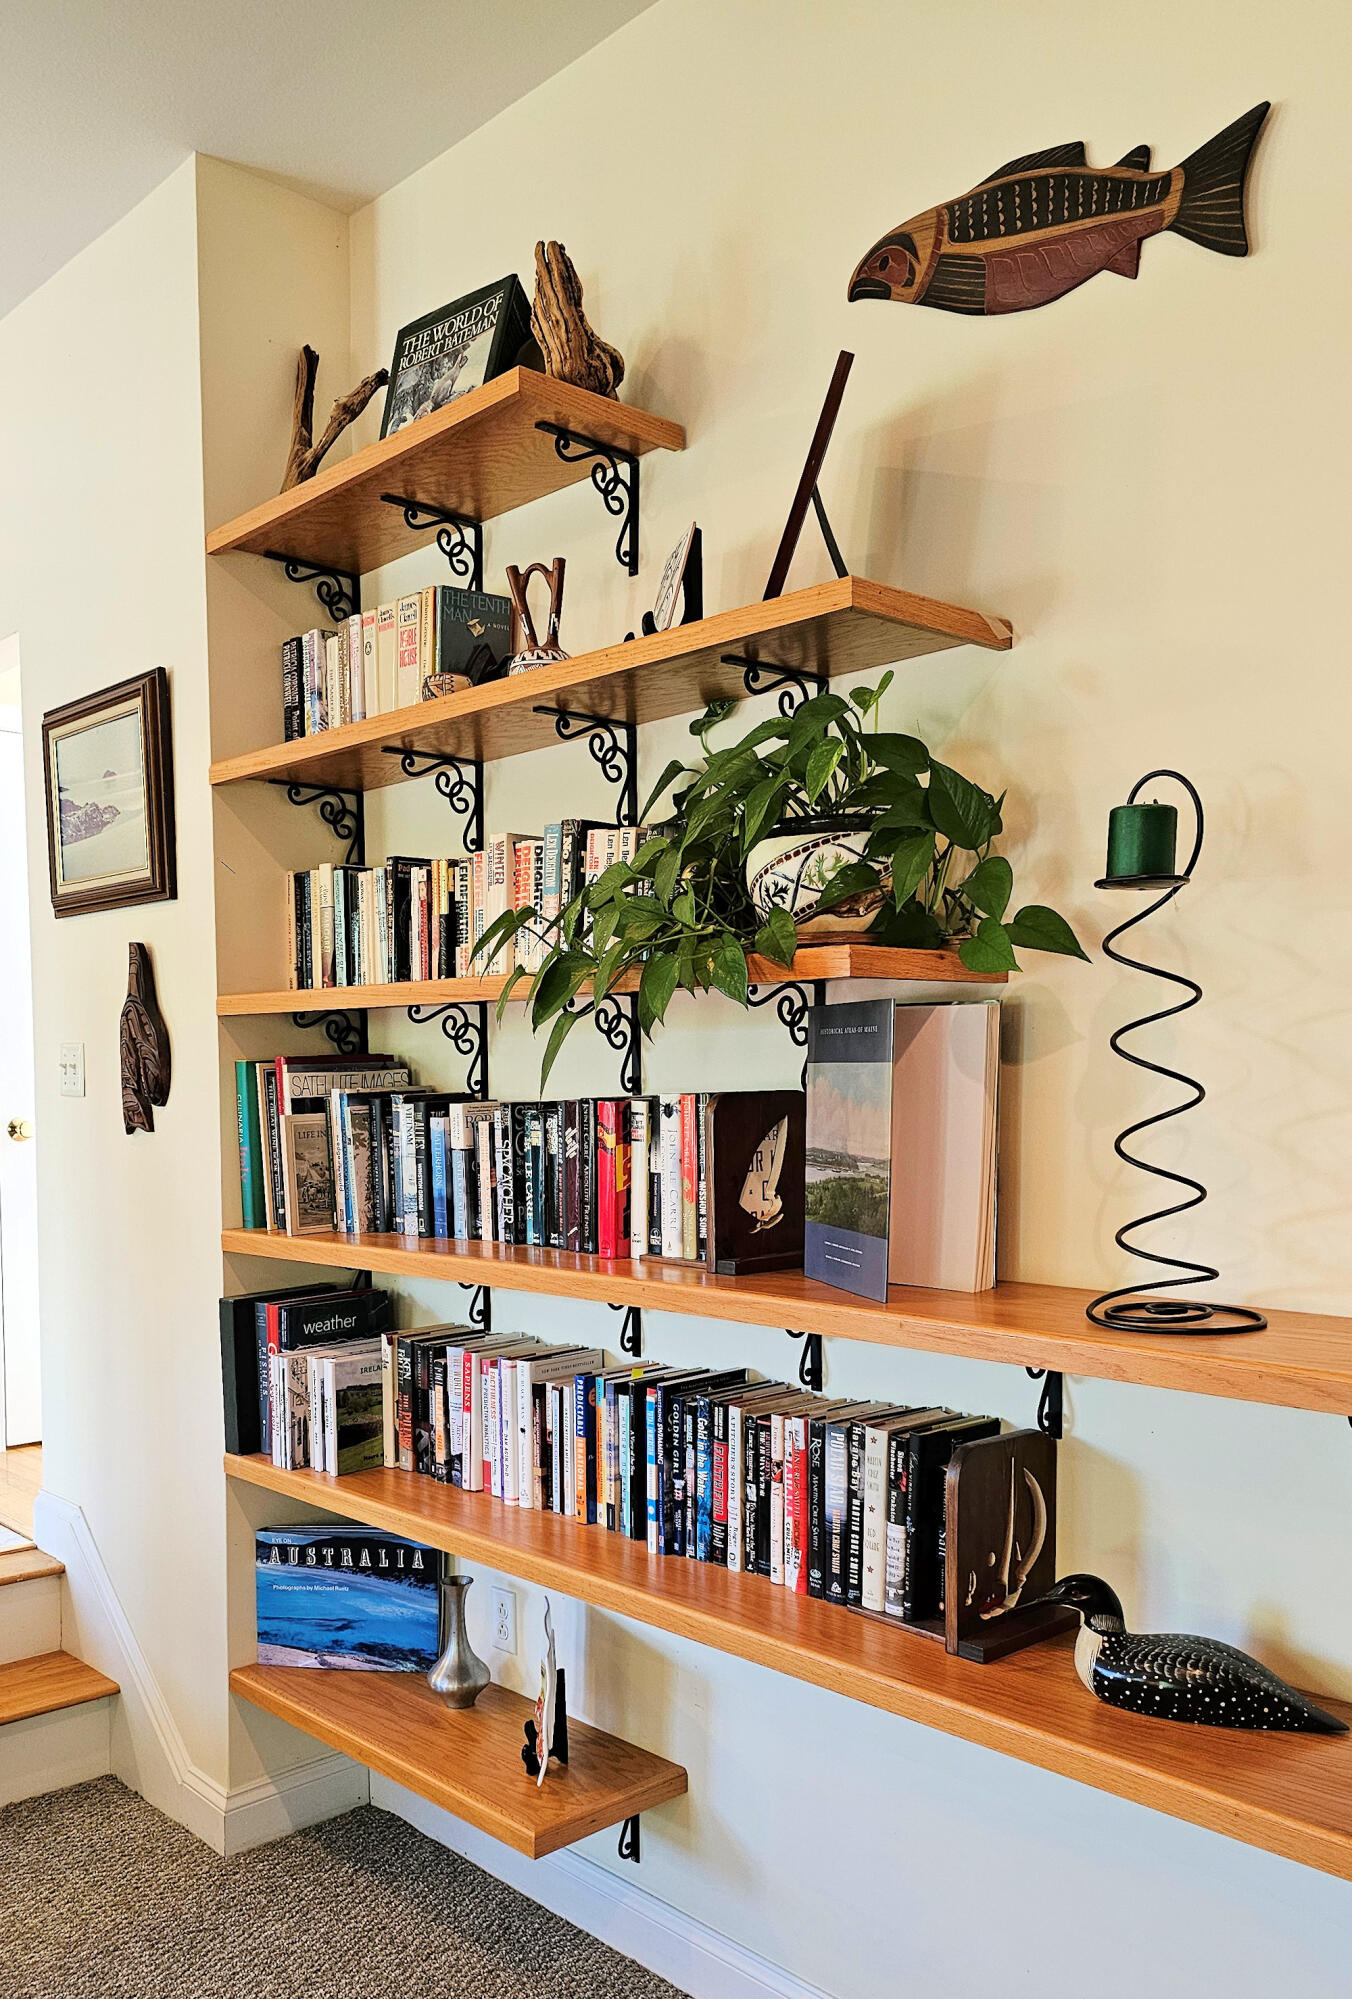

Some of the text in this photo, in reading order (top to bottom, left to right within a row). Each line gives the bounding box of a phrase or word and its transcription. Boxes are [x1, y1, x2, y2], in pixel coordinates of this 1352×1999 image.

[402, 292, 504, 356] THE WORLD OF
[398, 311, 499, 371] ROBERT BATEMAN
[443, 590, 510, 615] THE TENTH
[443, 606, 472, 623] MAN
[493, 624, 510, 632] NOVEL
[399, 647, 417, 668] HOUSE
[283, 644, 292, 707] PATRICIA CORNWELL
[291, 673, 299, 706] CORNWELL
[292, 709, 300, 730] Point
[563, 835, 572, 860] No
[607, 834, 615, 849] Len
[459, 858, 468, 882] LEN
[495, 840, 505, 885] WINTER
[546, 833, 558, 888] LEN DEIGHTON
[475, 853, 483, 909] FIGHTER
[387, 906, 393, 914] to
[459, 884, 468, 944] DEIGHTON
[819, 1025, 878, 1035] HISTORICAL ATLAS OF MAINE
[291, 1071, 409, 1097] SATELLITE IMAGES
[405, 1107, 414, 1145] VIETNAM
[682, 1101, 691, 1121] JOHN
[297, 1131, 315, 1140] LIFE
[415, 1122, 425, 1150] ALLIES
[667, 1129, 679, 1161] JOHN
[240, 1146, 250, 1184] Italy
[433, 1131, 443, 1186] MATTERHORN
[525, 1162, 532, 1179] LE
[502, 1140, 514, 1224] SPYCATCHER
[667, 1170, 679, 1184] LE
[698, 1181, 707, 1239] MISSION SONG
[303, 1314, 357, 1335] weather
[402, 1357, 411, 1379] KEN
[452, 1355, 463, 1397] THE WORLD
[576, 1379, 585, 1491] PREDICTABLY IRRATIONAL
[672, 1403, 680, 1474] GOLDEN GIRL
[697, 1417, 708, 1498] Gold in the Water
[746, 1429, 755, 1481] Lance Armstrong
[810, 1437, 822, 1468] ROSE
[830, 1431, 845, 1506] POLAR STAR
[849, 1426, 861, 1492] Havana Bay
[897, 1451, 905, 1473] Simon
[714, 1445, 723, 1516] FAITHFUL
[793, 1465, 801, 1560] CRUZ SMITH DECEMBER
[811, 1474, 820, 1551] MARTIN CRUZ SMITH
[832, 1509, 841, 1574] MARTIN CRUZ SMITH
[849, 1498, 861, 1585] MARTIN CRUZ SMITH
[867, 1527, 877, 1538] RED
[938, 1530, 946, 1557] Salt
[268, 1546, 424, 1569] AUSTRALIA
[272, 1584, 306, 1592] Photographs
